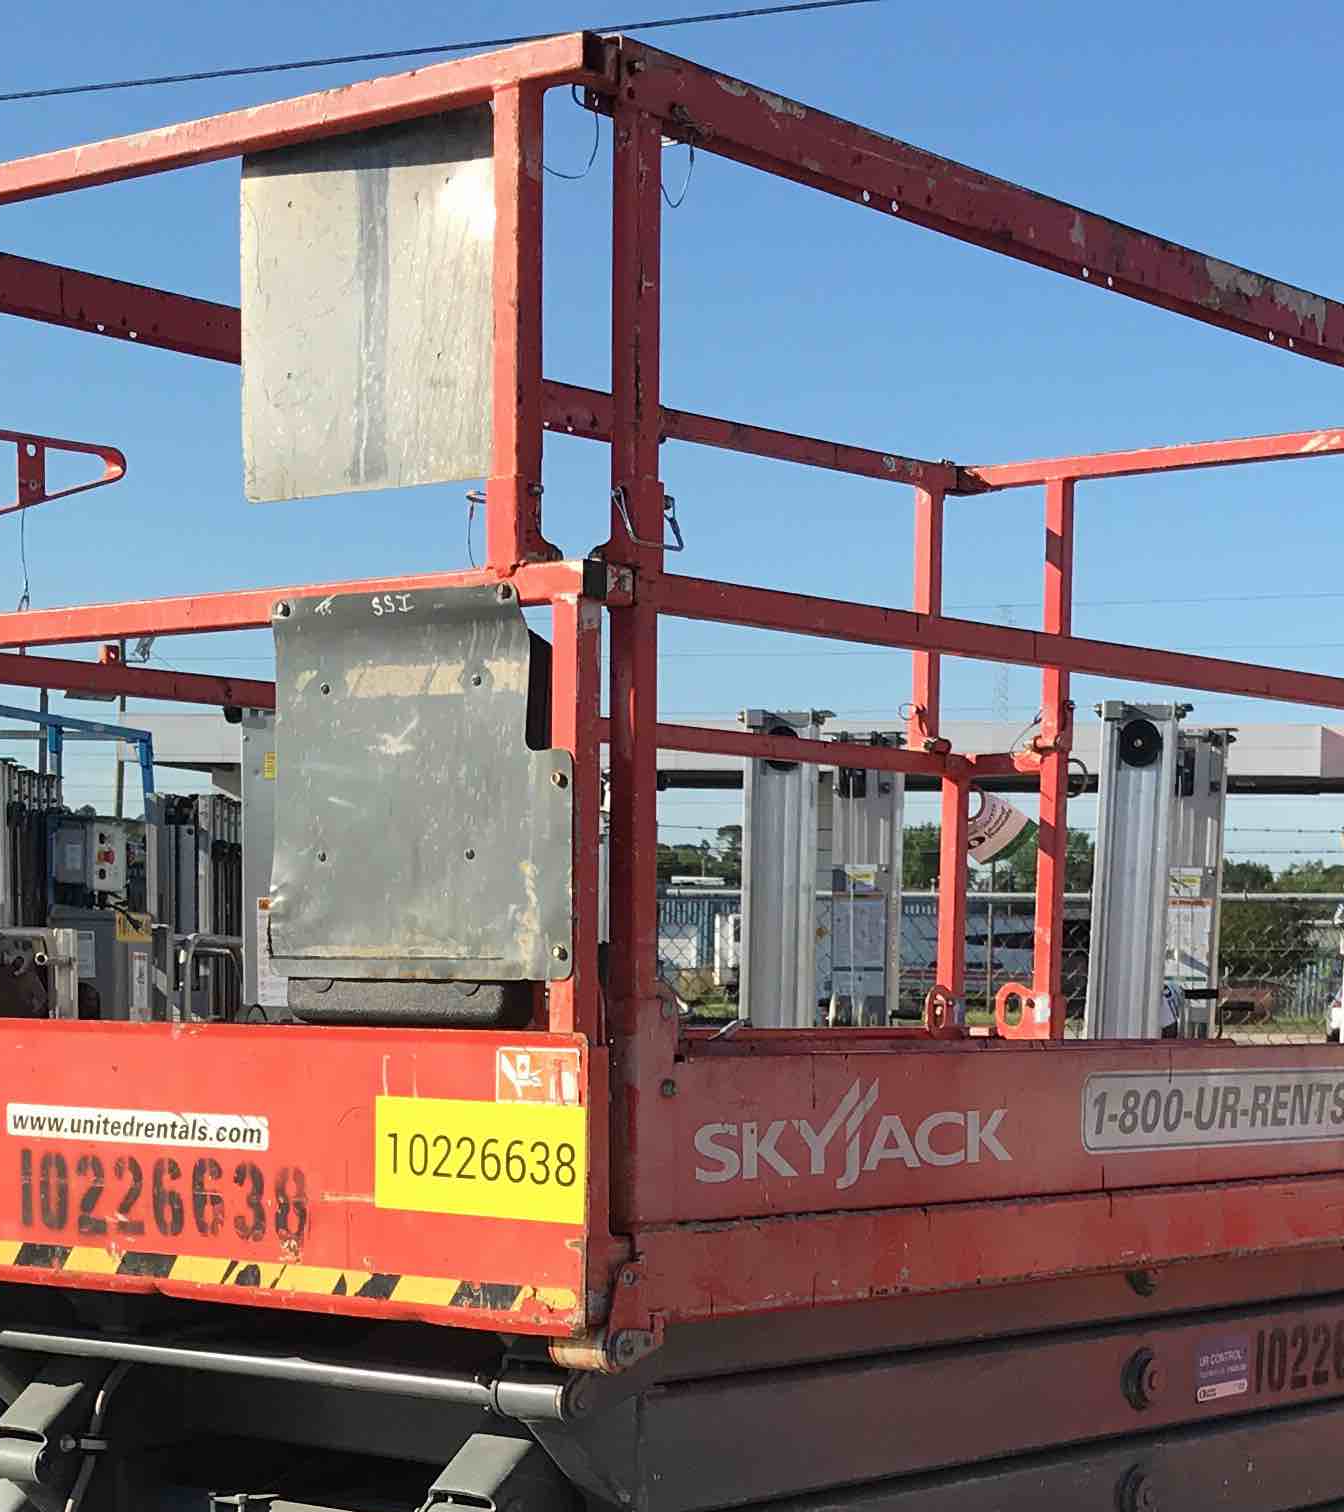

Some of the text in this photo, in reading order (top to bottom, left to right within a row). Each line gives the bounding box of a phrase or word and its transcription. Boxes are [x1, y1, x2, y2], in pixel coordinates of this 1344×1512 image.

[12, 1111, 263, 1145] www.unitedrentals.com
[387, 1132, 577, 1188] 10226638
[693, 1077, 1013, 1190] SKYJACK
[19, 1147, 309, 1243] 10226638
